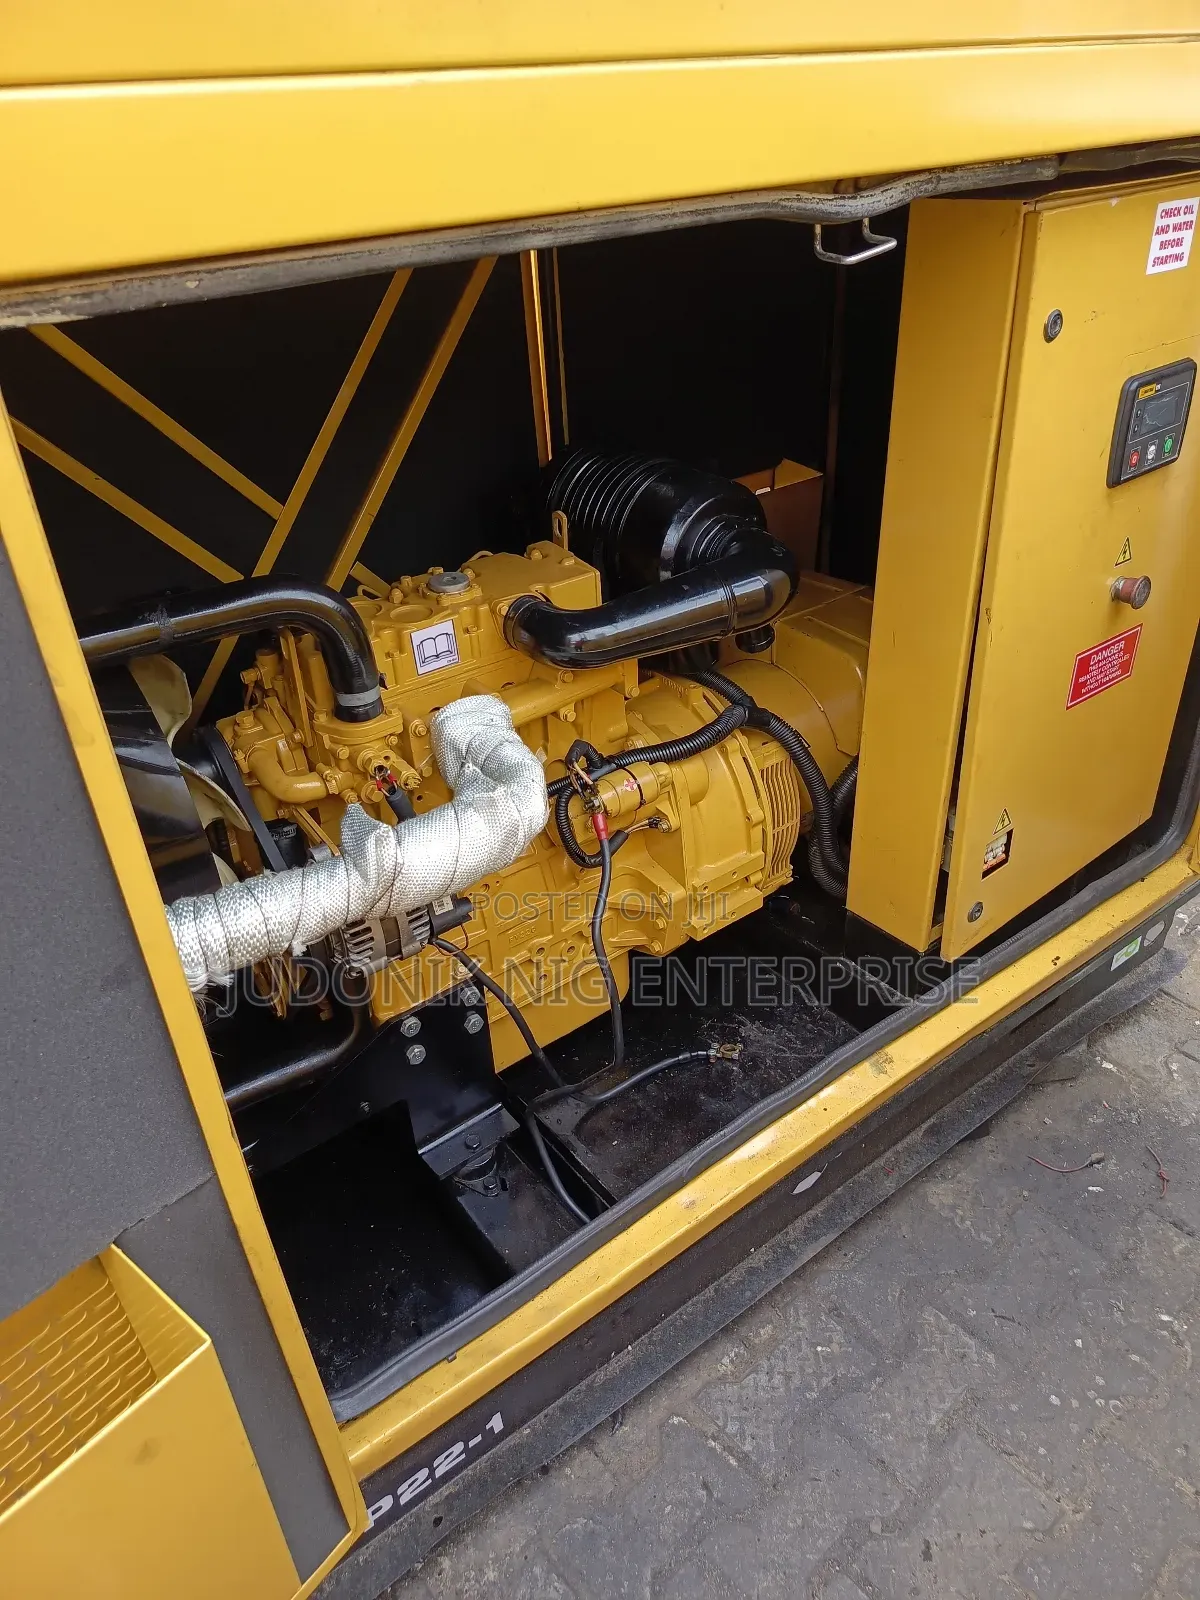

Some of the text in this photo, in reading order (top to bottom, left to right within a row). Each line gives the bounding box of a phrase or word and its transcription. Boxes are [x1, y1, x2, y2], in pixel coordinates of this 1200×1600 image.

[1160, 204, 1195, 219] CHECK OIL
[1154, 220, 1194, 236] AND WATER
[1159, 237, 1184, 250] BEFORE
[1151, 252, 1185, 267] STARTING
[1090, 641, 1125, 665] DANGER
[364, 1412, 504, 1532] P22-1
